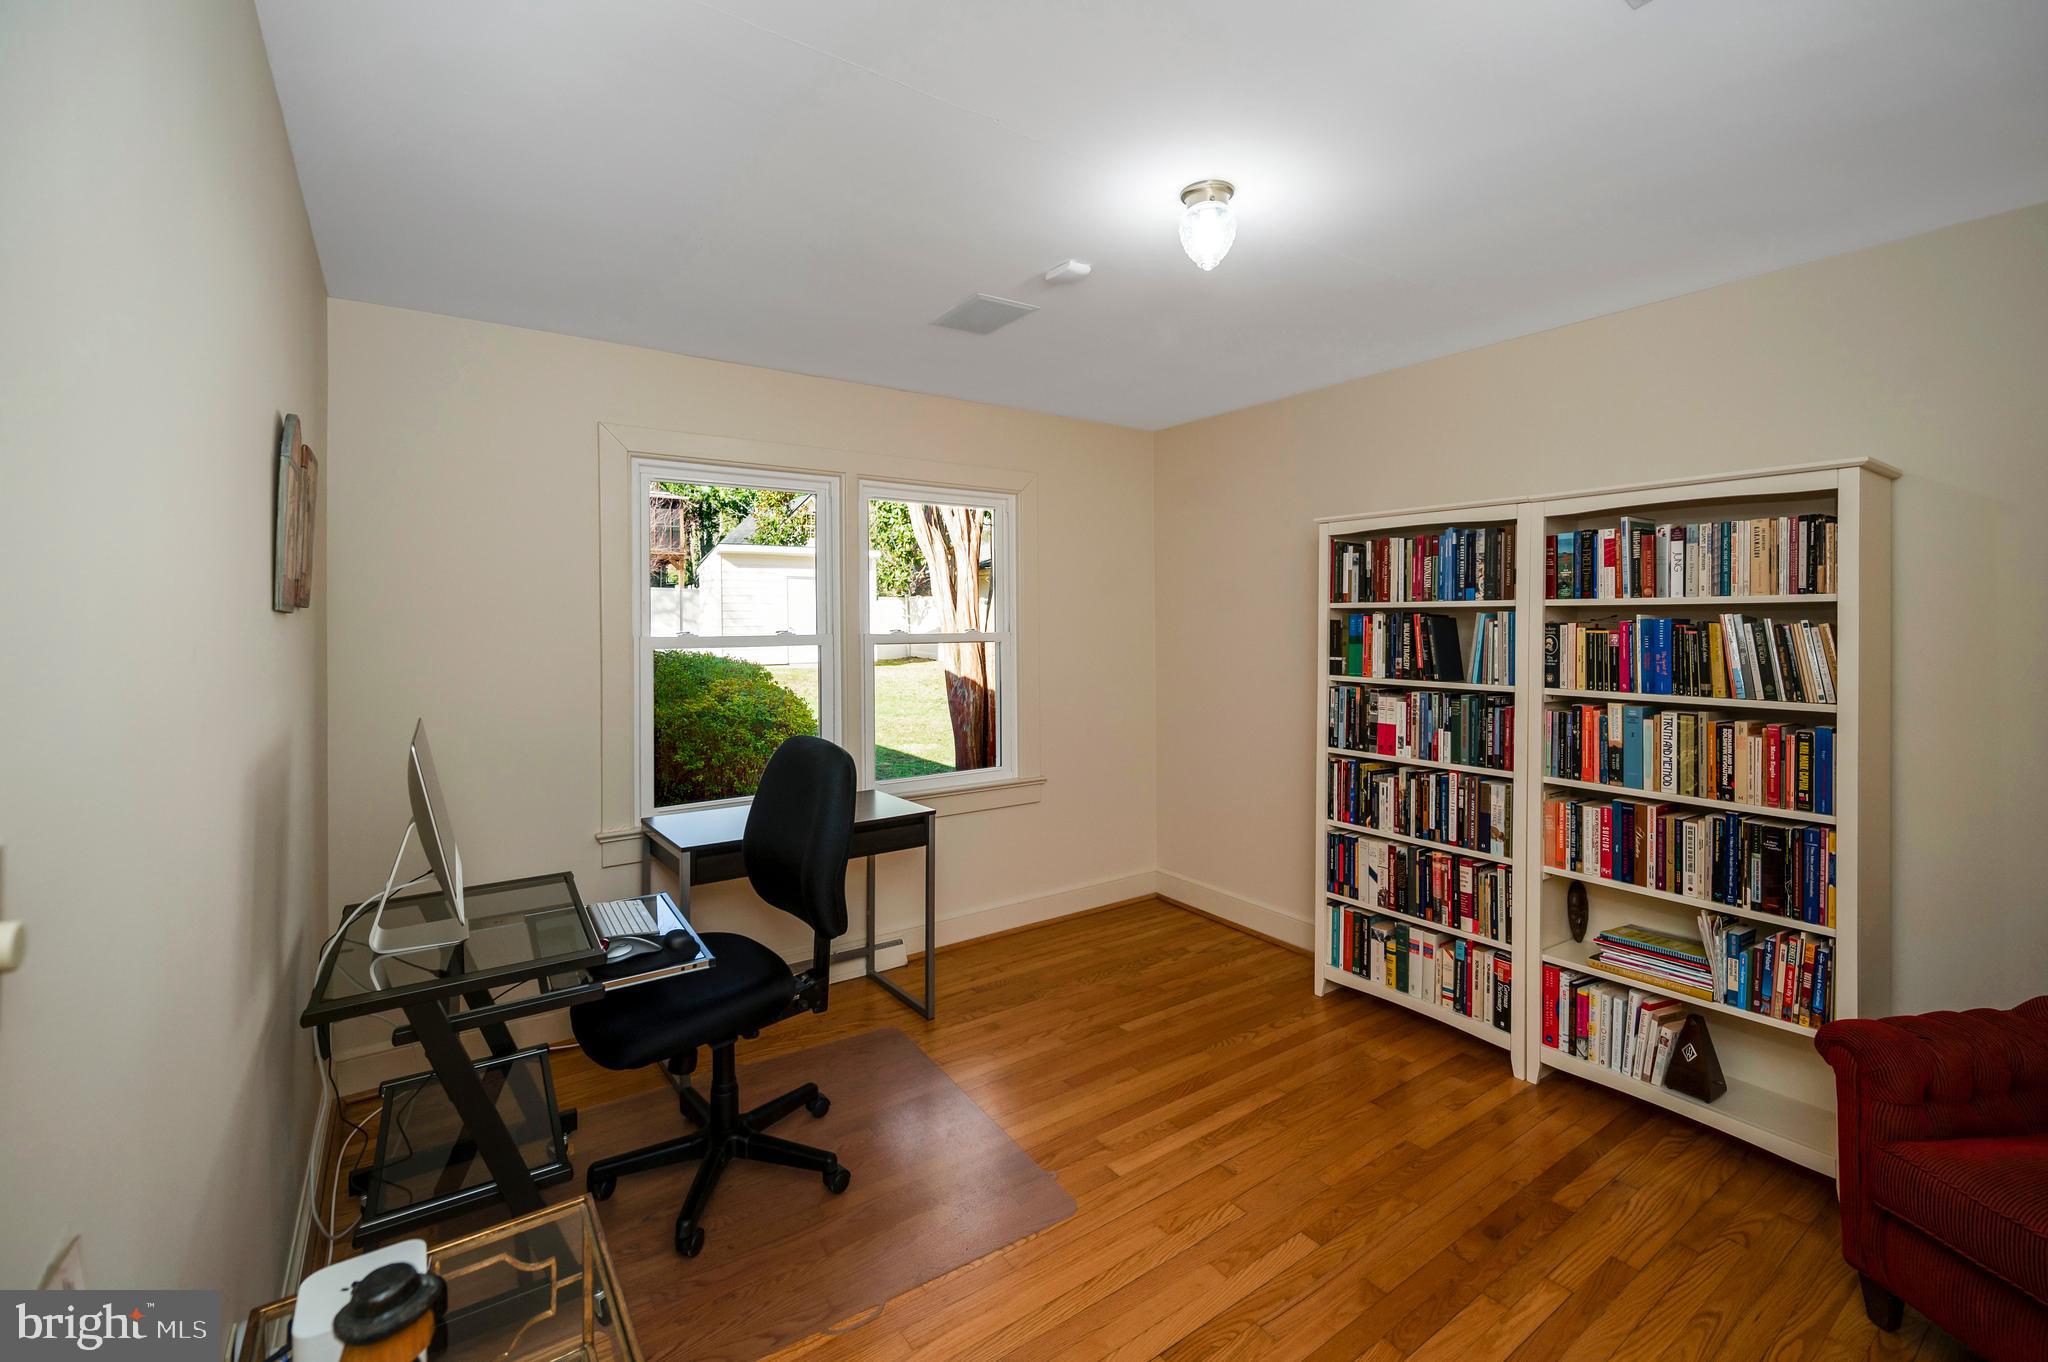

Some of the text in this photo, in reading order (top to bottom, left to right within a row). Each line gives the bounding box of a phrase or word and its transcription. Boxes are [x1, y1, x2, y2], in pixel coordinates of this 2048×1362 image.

[1582, 550, 1591, 574] FREUD
[1673, 552, 1682, 572] JUNG
[1663, 718, 1673, 786] TRUTH AND METHOD
